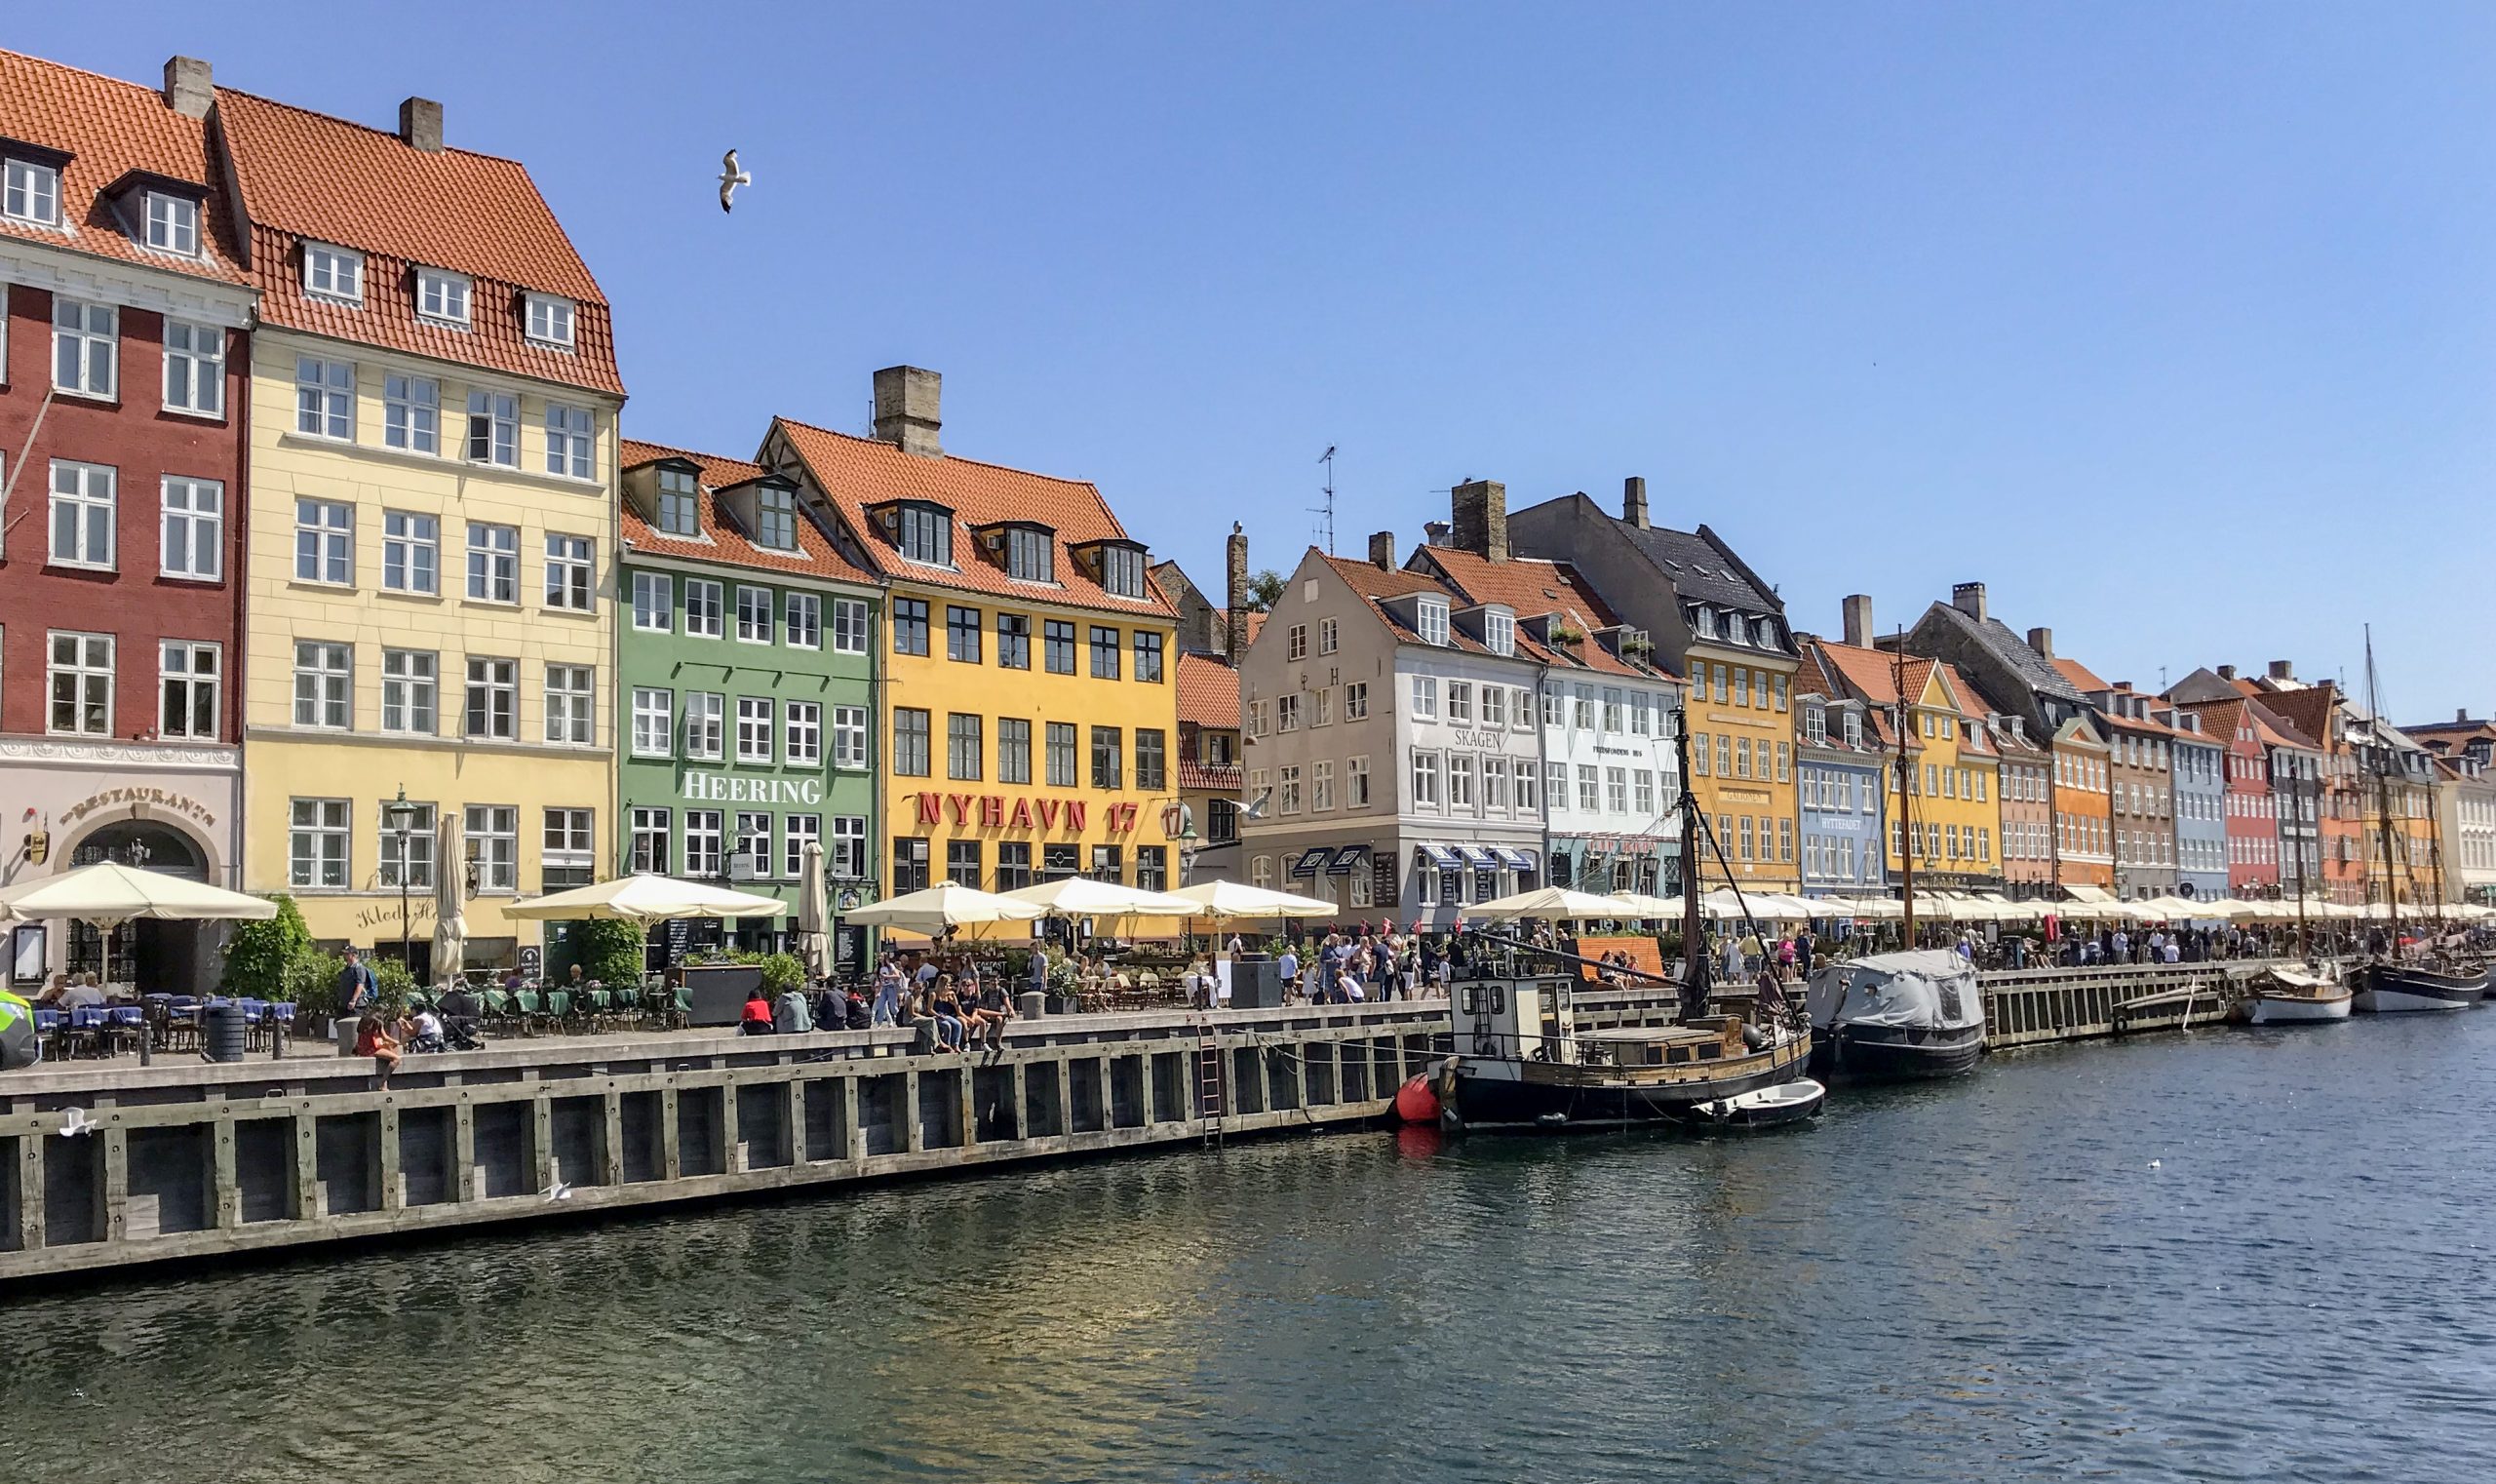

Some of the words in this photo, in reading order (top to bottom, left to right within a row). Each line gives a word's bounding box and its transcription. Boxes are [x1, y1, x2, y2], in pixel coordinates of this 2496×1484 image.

[1330, 668, 1339, 685] H
[1456, 730, 1501, 748] SKAGEN
[682, 771, 822, 805] HEERING
[71, 787, 206, 821] RESTAURANT
[918, 791, 1088, 831] NYHAVN
[1108, 801, 1139, 832] 17
[1160, 807, 1181, 837] 17
[1821, 817, 1862, 831] HYTTEFADET
